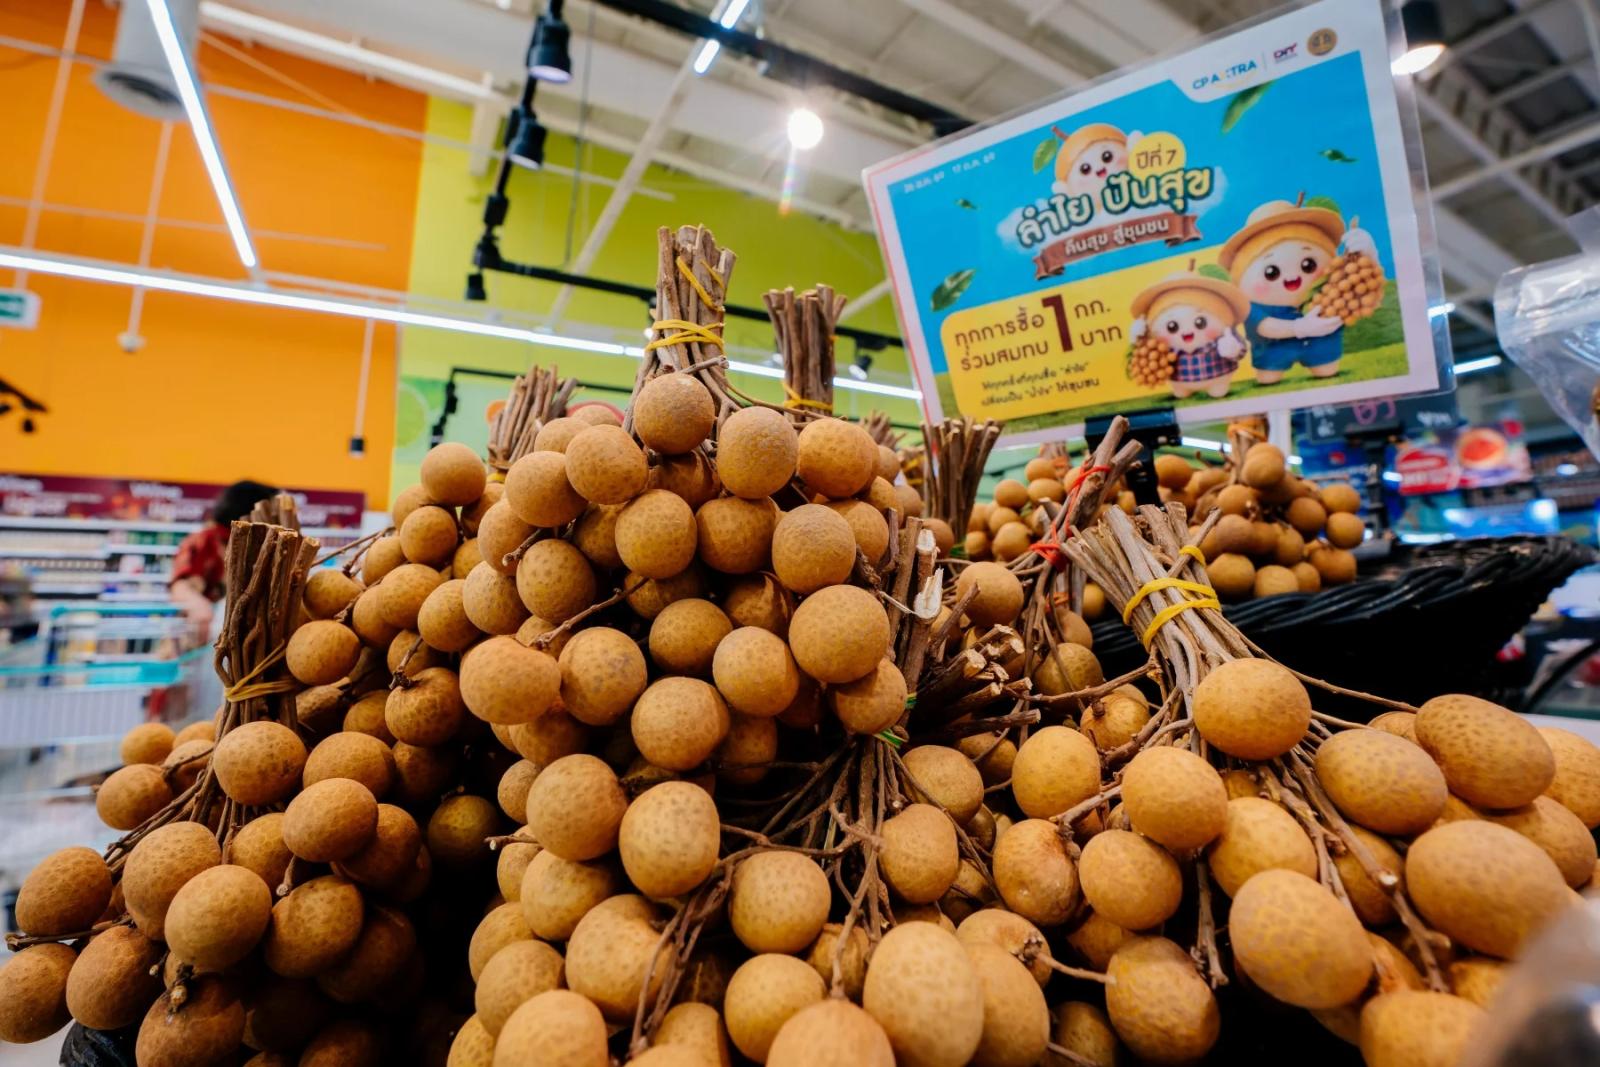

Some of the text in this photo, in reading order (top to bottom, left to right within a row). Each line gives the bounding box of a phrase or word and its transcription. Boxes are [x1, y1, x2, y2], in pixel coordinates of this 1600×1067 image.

[1136, 142, 1178, 170] ปีที่ 7
[1017, 165, 1213, 248] ลำไย ปันสุข
[1113, 217, 1170, 246] สู่ชุมชน
[955, 294, 1112, 353] ทุกการซื้อ 1 กก.
[960, 325, 1123, 372] ร่วมสมทบ บาท
